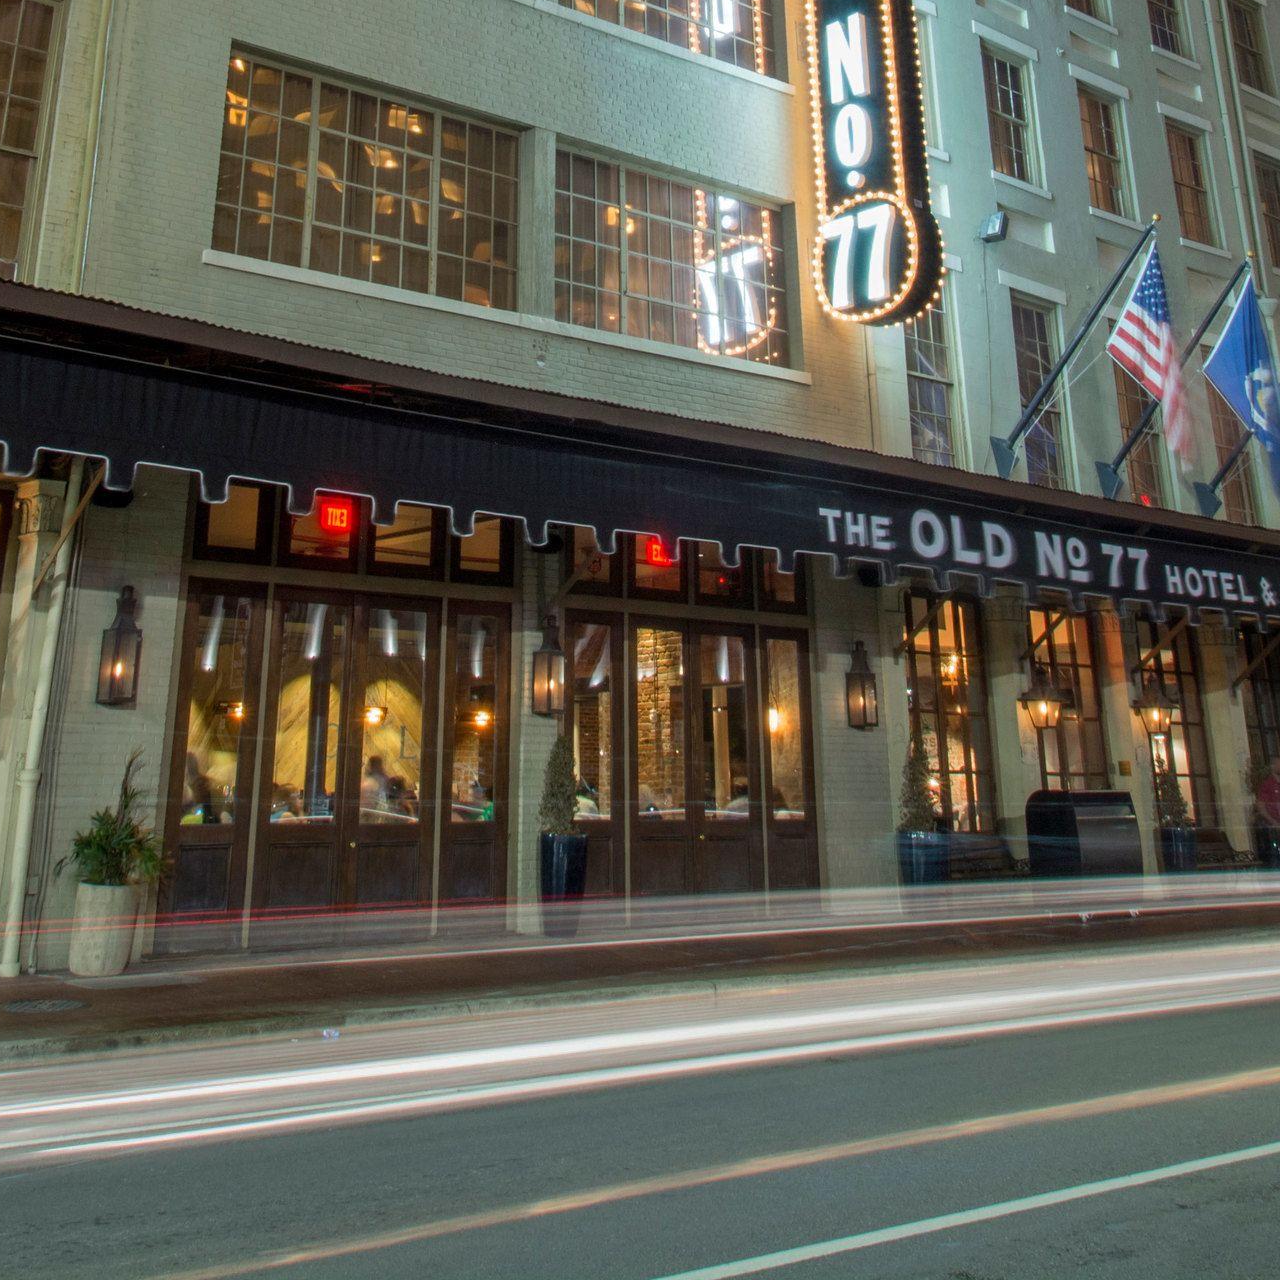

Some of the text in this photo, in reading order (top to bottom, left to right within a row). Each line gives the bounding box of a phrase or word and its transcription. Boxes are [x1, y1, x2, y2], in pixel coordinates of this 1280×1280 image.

[822, 203, 896, 310] 77
[818, 507, 896, 551] THE
[910, 508, 1017, 569] OLD
[1100, 542, 1150, 592] 77
[1164, 564, 1256, 604] HOTEL
[1259, 576, 1277, 607] &
